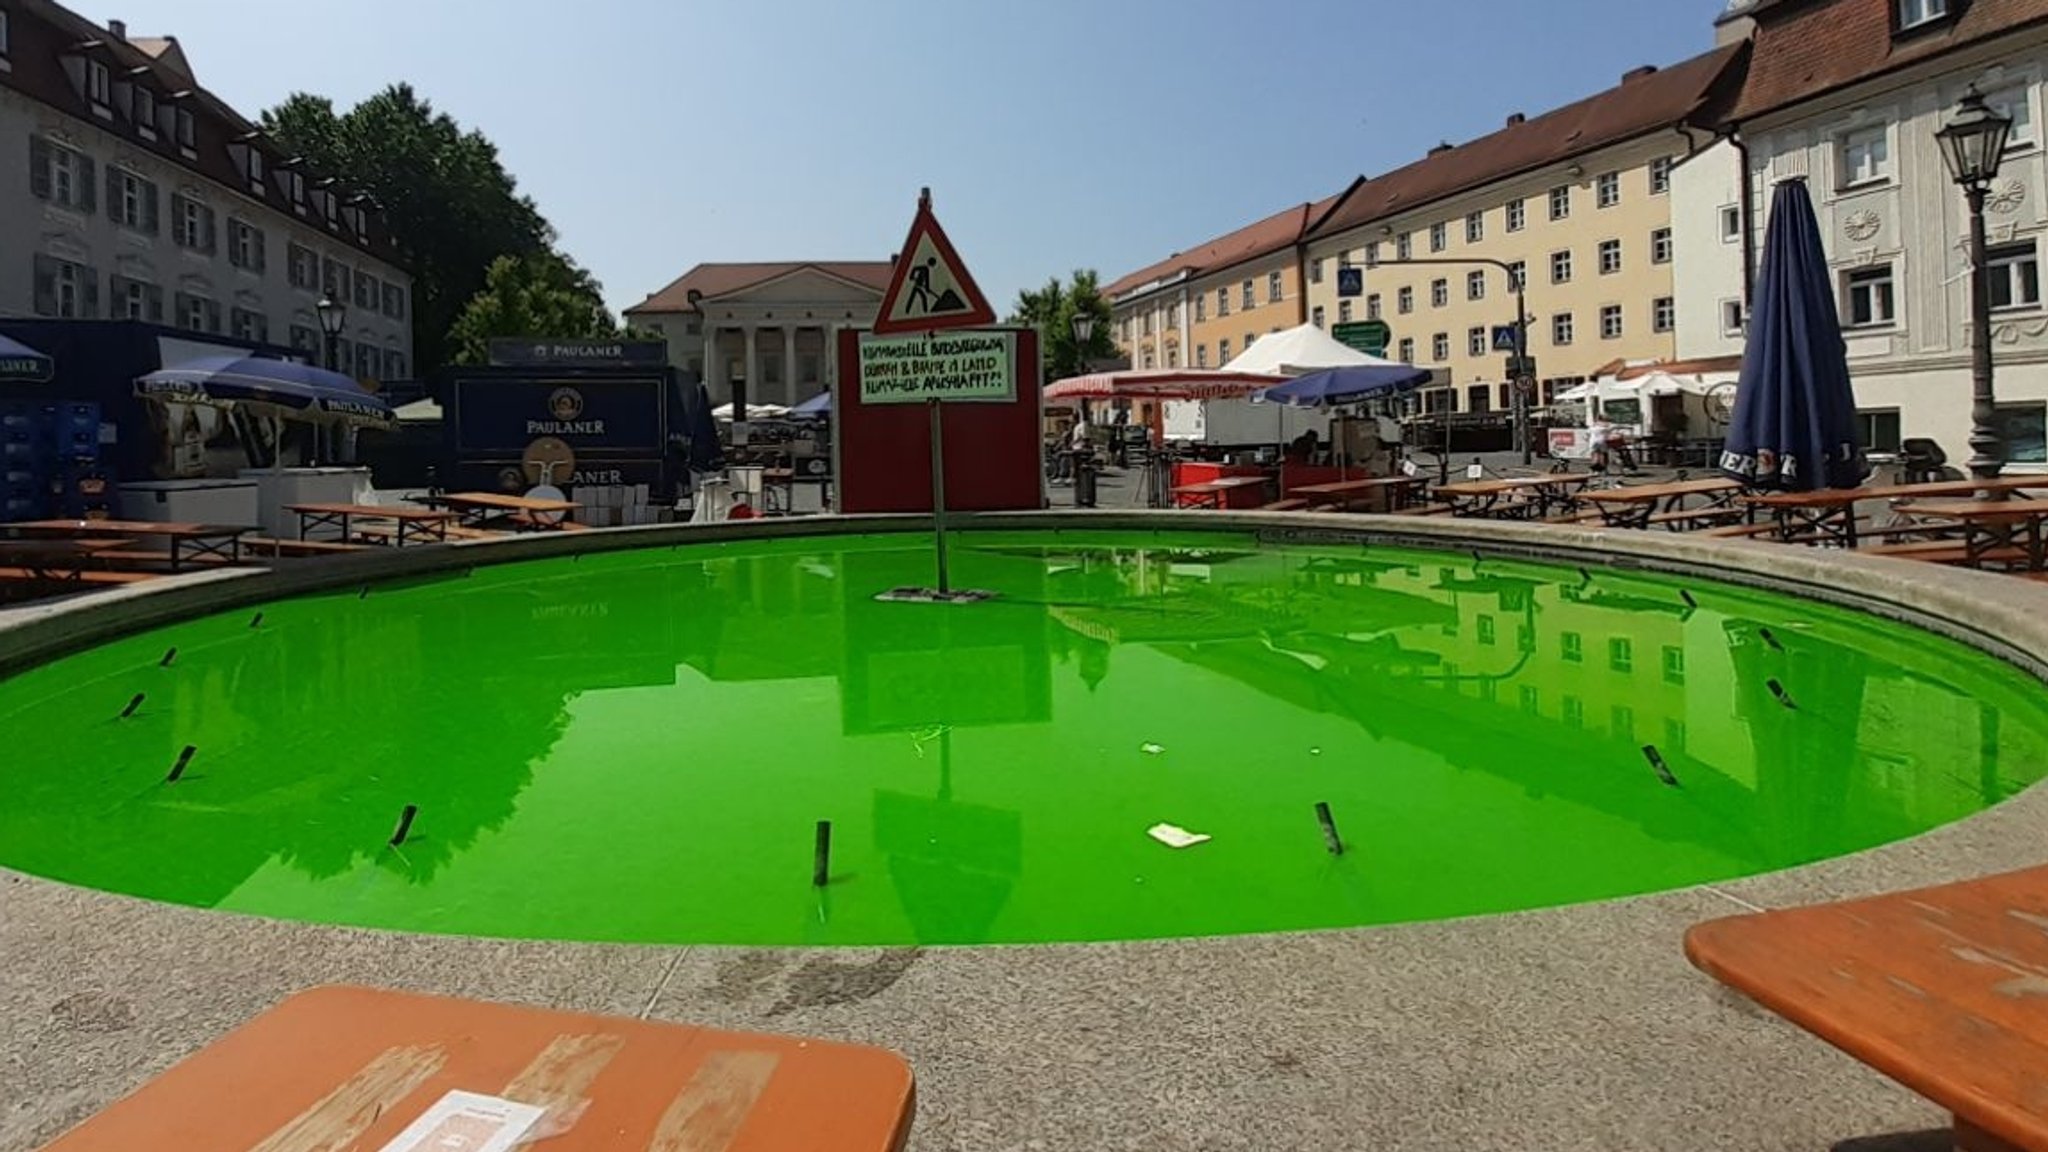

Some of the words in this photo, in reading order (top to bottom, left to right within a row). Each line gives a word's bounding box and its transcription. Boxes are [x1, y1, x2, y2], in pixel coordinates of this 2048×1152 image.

[554, 345, 624, 357] PAULANER
[962, 356, 997, 372] LAND
[526, 420, 605, 434] PAULANER
